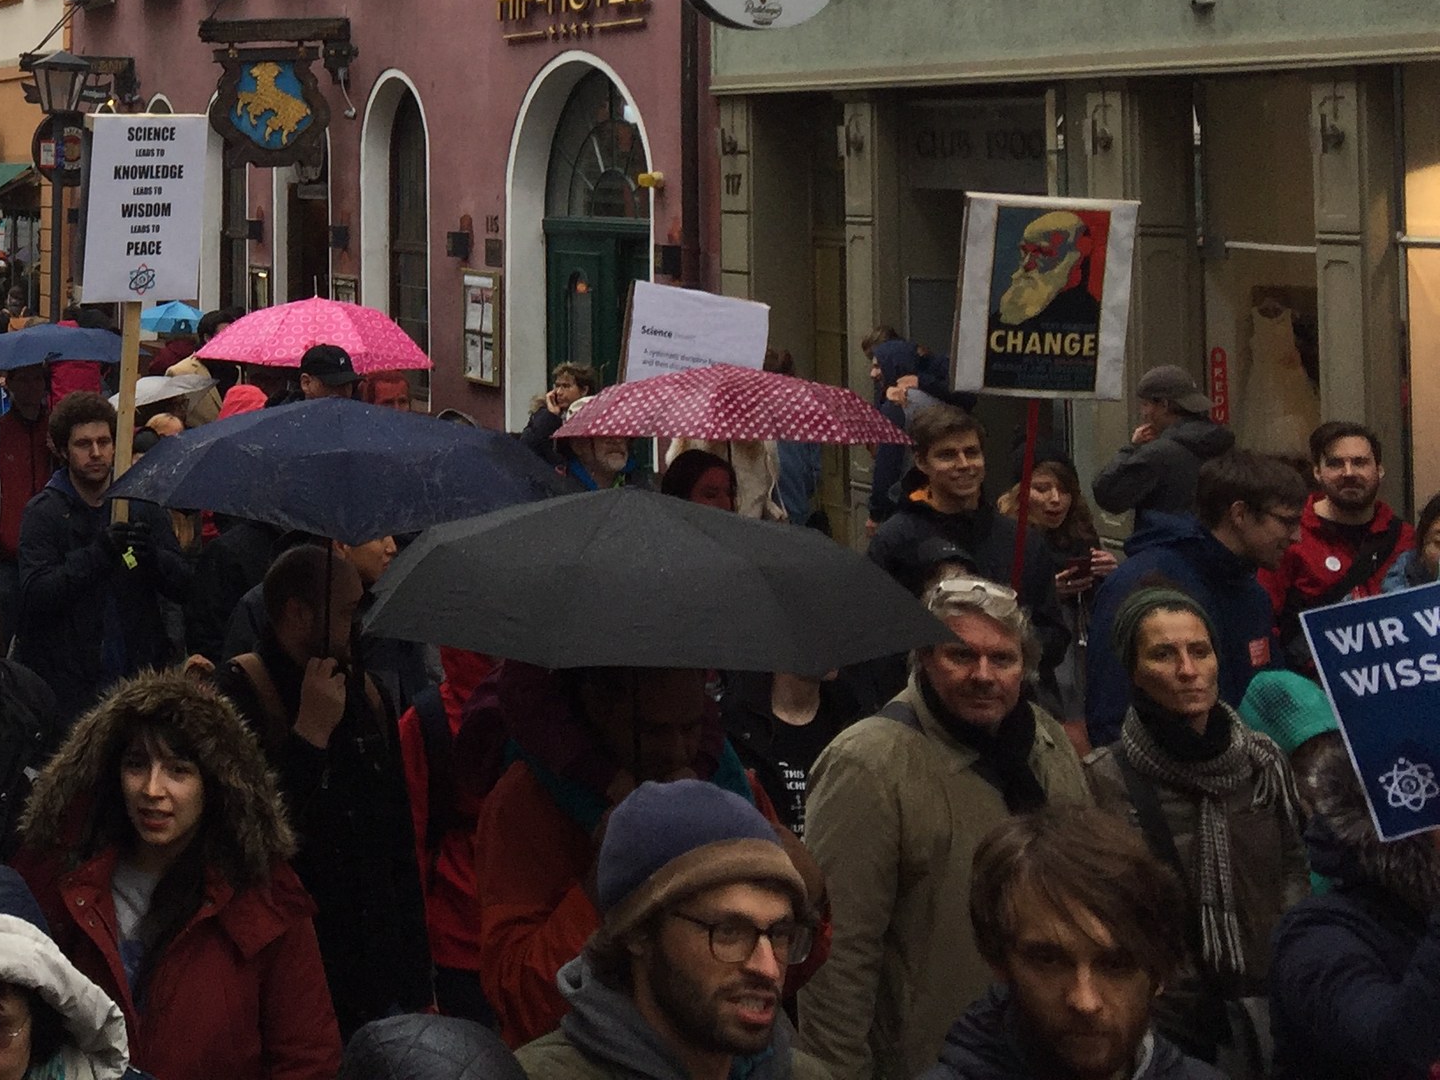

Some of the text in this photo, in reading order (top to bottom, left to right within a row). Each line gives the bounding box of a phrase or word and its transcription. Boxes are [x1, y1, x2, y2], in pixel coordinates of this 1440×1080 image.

[127, 126, 176, 142] SCIENCE
[135, 148, 165, 158] LEADS TO
[113, 164, 184, 180] KNOWLEDGE
[133, 186, 163, 196] LEADS TO
[724, 173, 742, 195] 117
[121, 202, 172, 218] WISDOM
[130, 224, 160, 234] LEADS TO
[126, 241, 162, 256] PEACE
[641, 325, 673, 340] Science
[990, 329, 1097, 357] CHANGE
[1324, 617, 1410, 655] WIR
[1340, 653, 1440, 697] WISS
[783, 770, 805, 779] THIS
